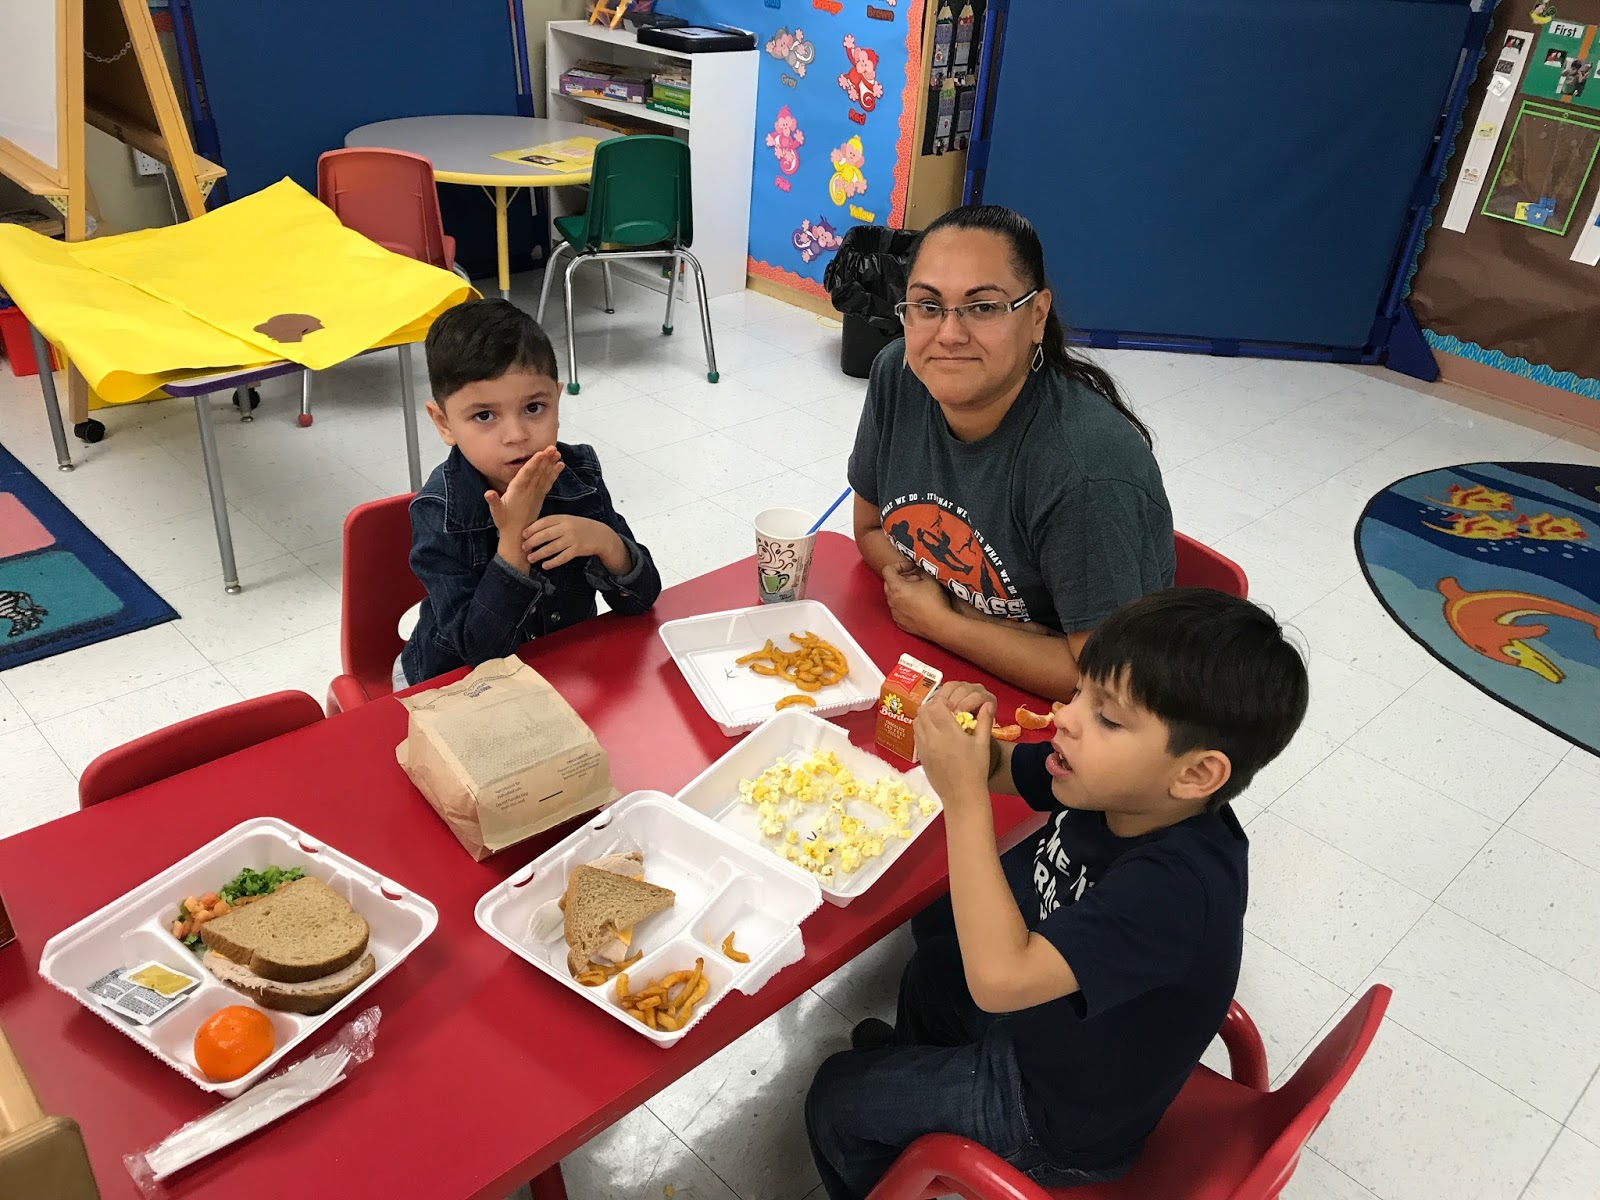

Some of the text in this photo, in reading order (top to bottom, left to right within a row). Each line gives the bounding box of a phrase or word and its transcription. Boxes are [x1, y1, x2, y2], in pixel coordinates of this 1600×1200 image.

[867, 5, 894, 21] Brown
[1554, 24, 1577, 37] First
[781, 74, 797, 89] Gray
[849, 109, 866, 125] Red
[775, 176, 791, 192] Pink
[850, 205, 875, 222] Yellow
[881, 501, 894, 517] WHAT
[895, 495, 906, 505] WE
[908, 493, 918, 501] DO
[956, 506, 968, 518] WE
[983, 543, 1002, 567] WHAT
[1000, 569, 1011, 584] WE
